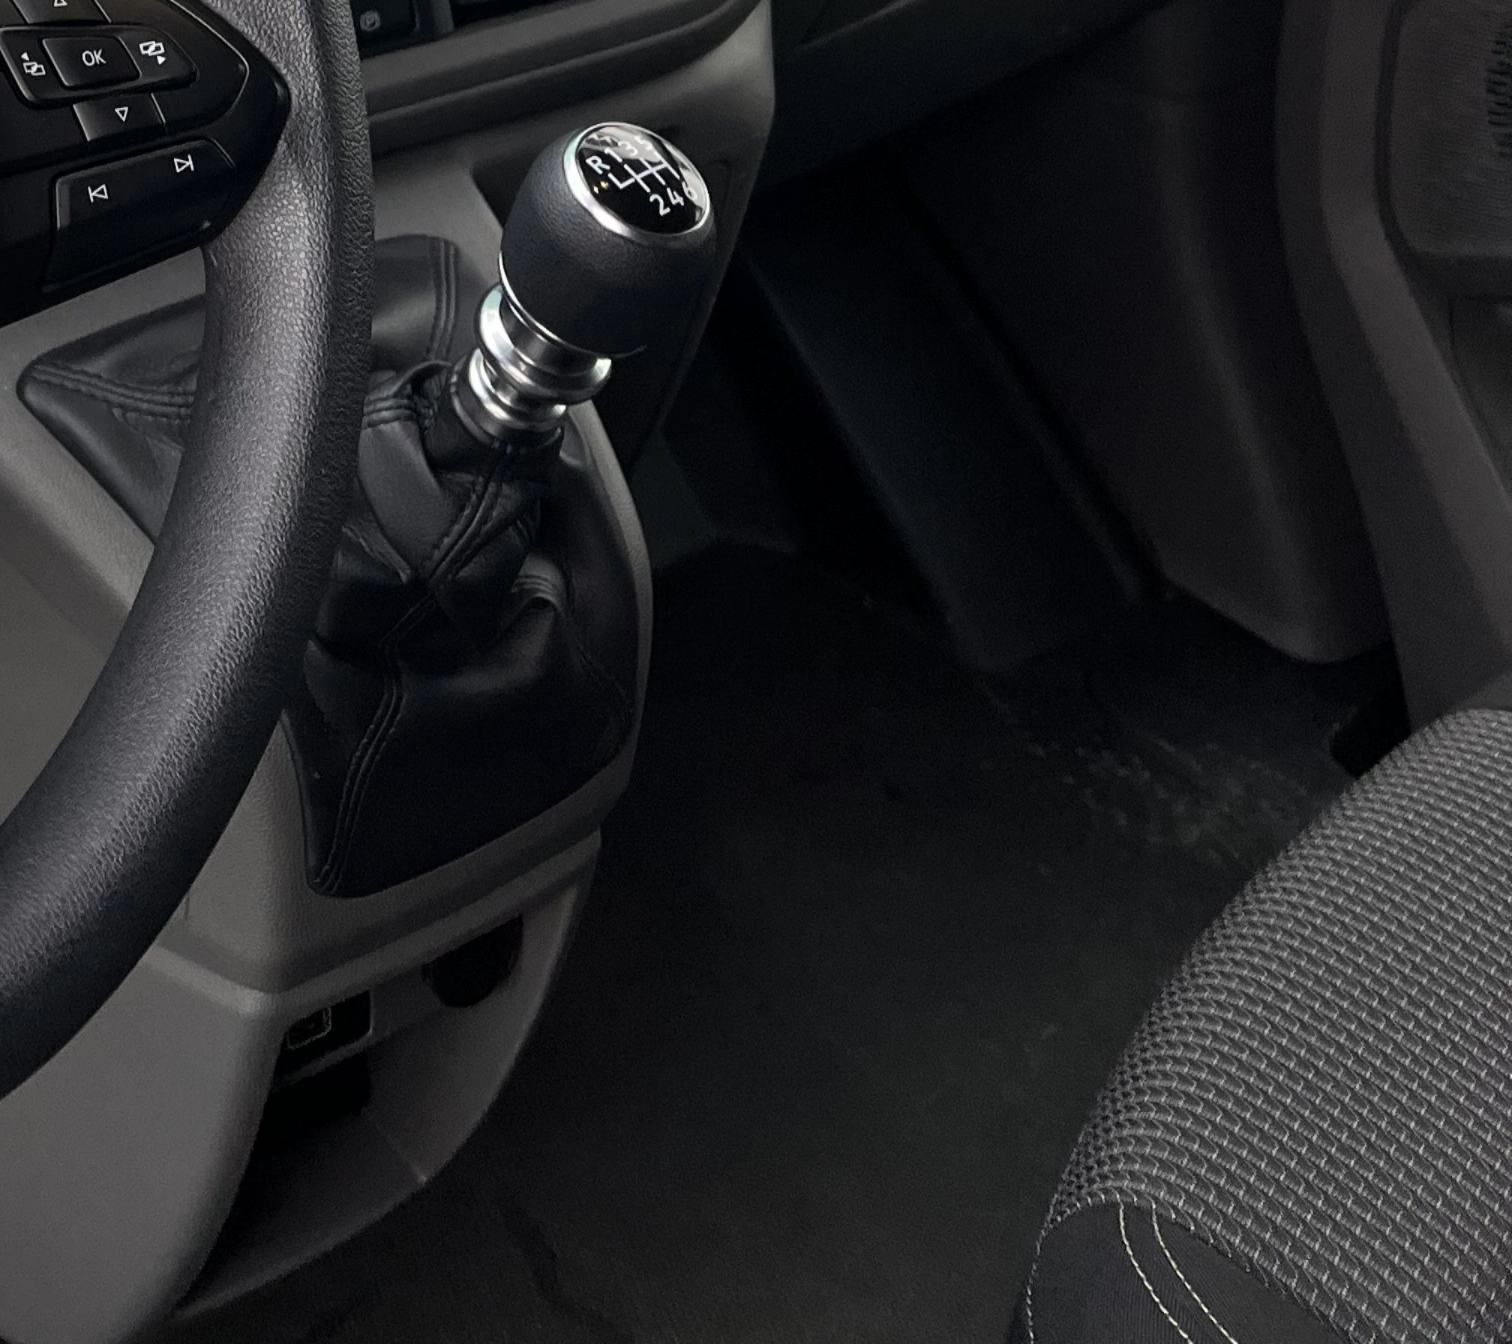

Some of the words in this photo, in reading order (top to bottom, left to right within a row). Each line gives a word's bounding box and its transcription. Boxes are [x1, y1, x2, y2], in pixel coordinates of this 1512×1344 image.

[82, 47, 107, 69] OK
[585, 155, 611, 176] R
[618, 140, 638, 156] 3
[635, 135, 654, 151] 5
[649, 194, 671, 217] 2
[667, 187, 685, 207] 4
[682, 181, 698, 201] 6
